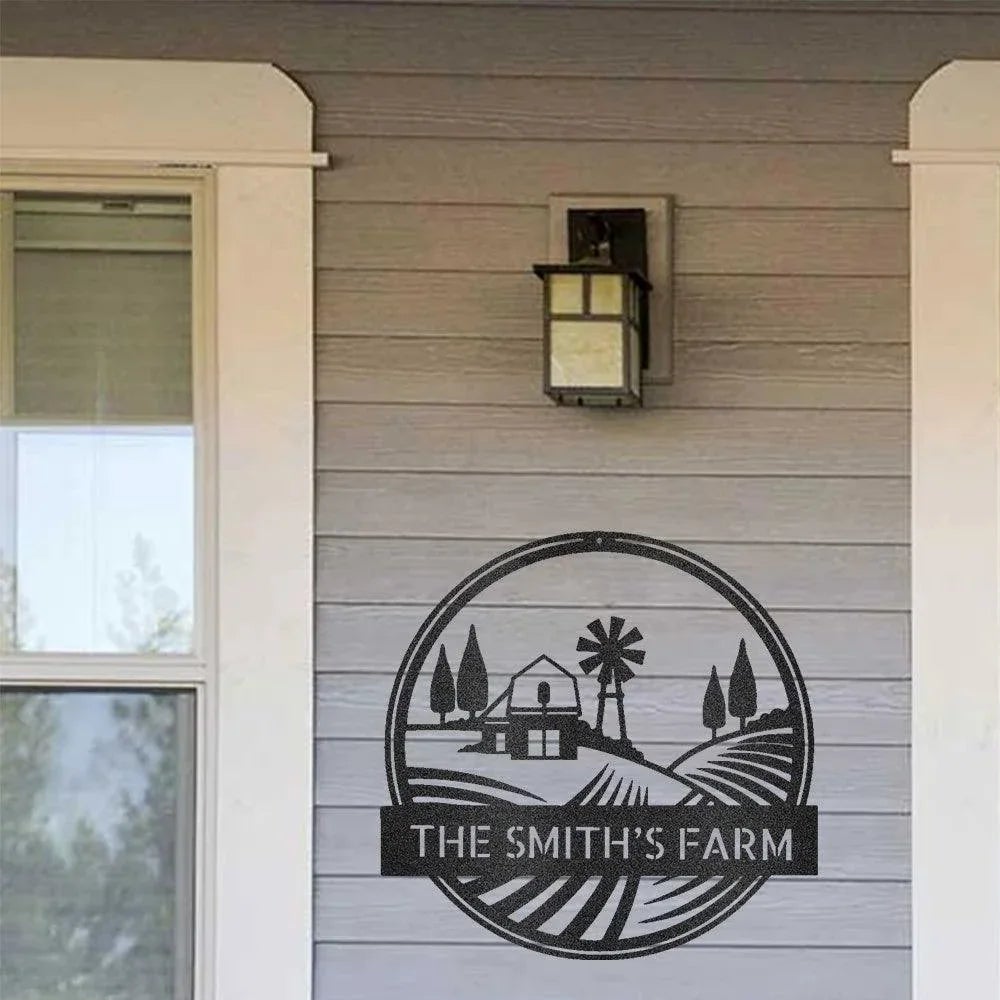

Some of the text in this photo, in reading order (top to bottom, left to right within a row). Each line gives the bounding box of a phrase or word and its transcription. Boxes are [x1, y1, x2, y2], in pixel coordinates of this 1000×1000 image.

[410, 825, 793, 861] THE SMITH'S FARM
